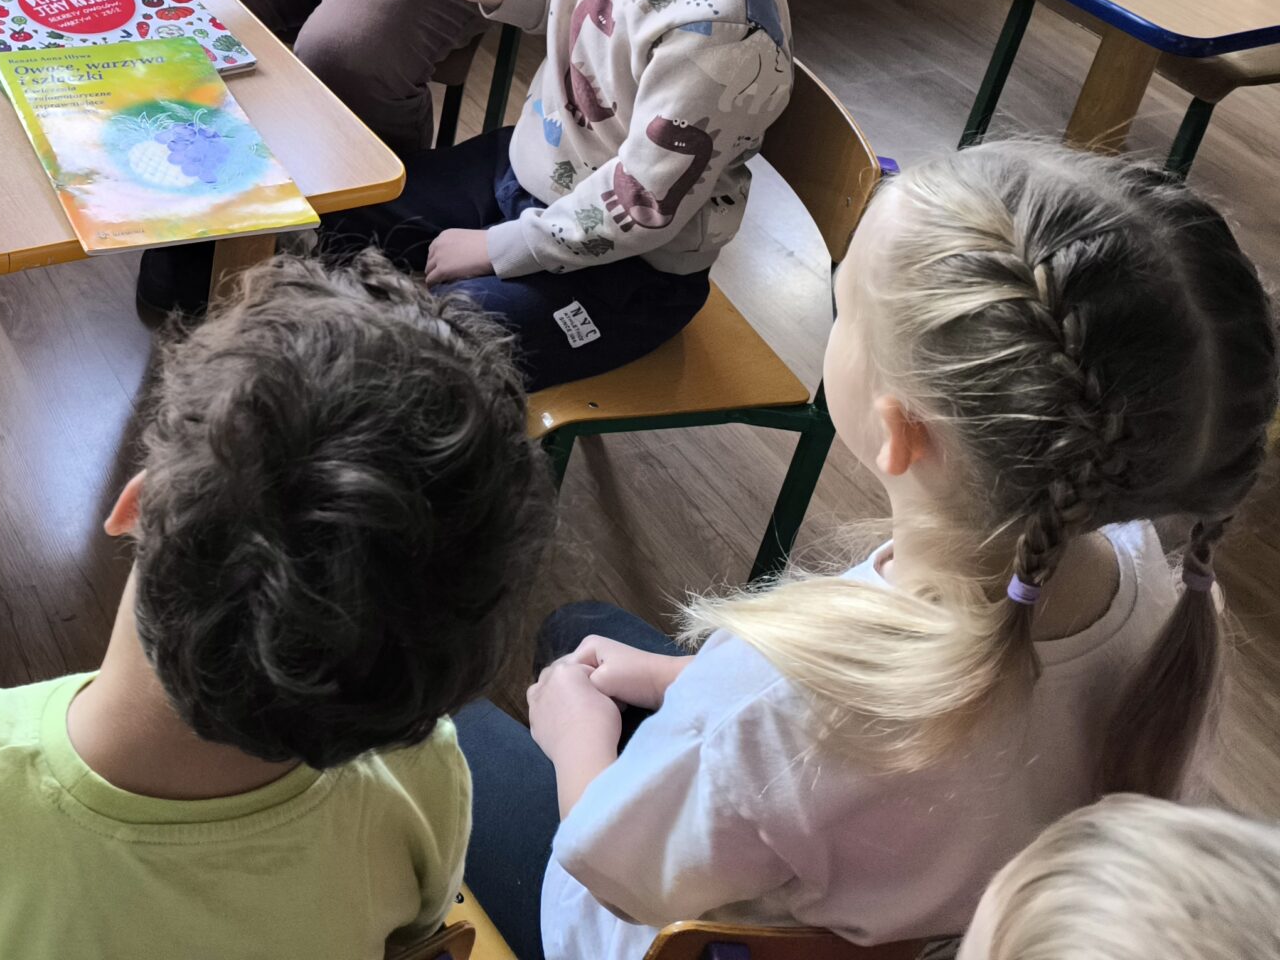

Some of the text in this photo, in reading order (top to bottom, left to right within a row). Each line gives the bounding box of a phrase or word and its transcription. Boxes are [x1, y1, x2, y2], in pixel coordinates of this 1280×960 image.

[33, 0, 71, 18] JEMY
[13, 55, 167, 77] Owoce, warzywa
[570, 306, 597, 337] NYC
